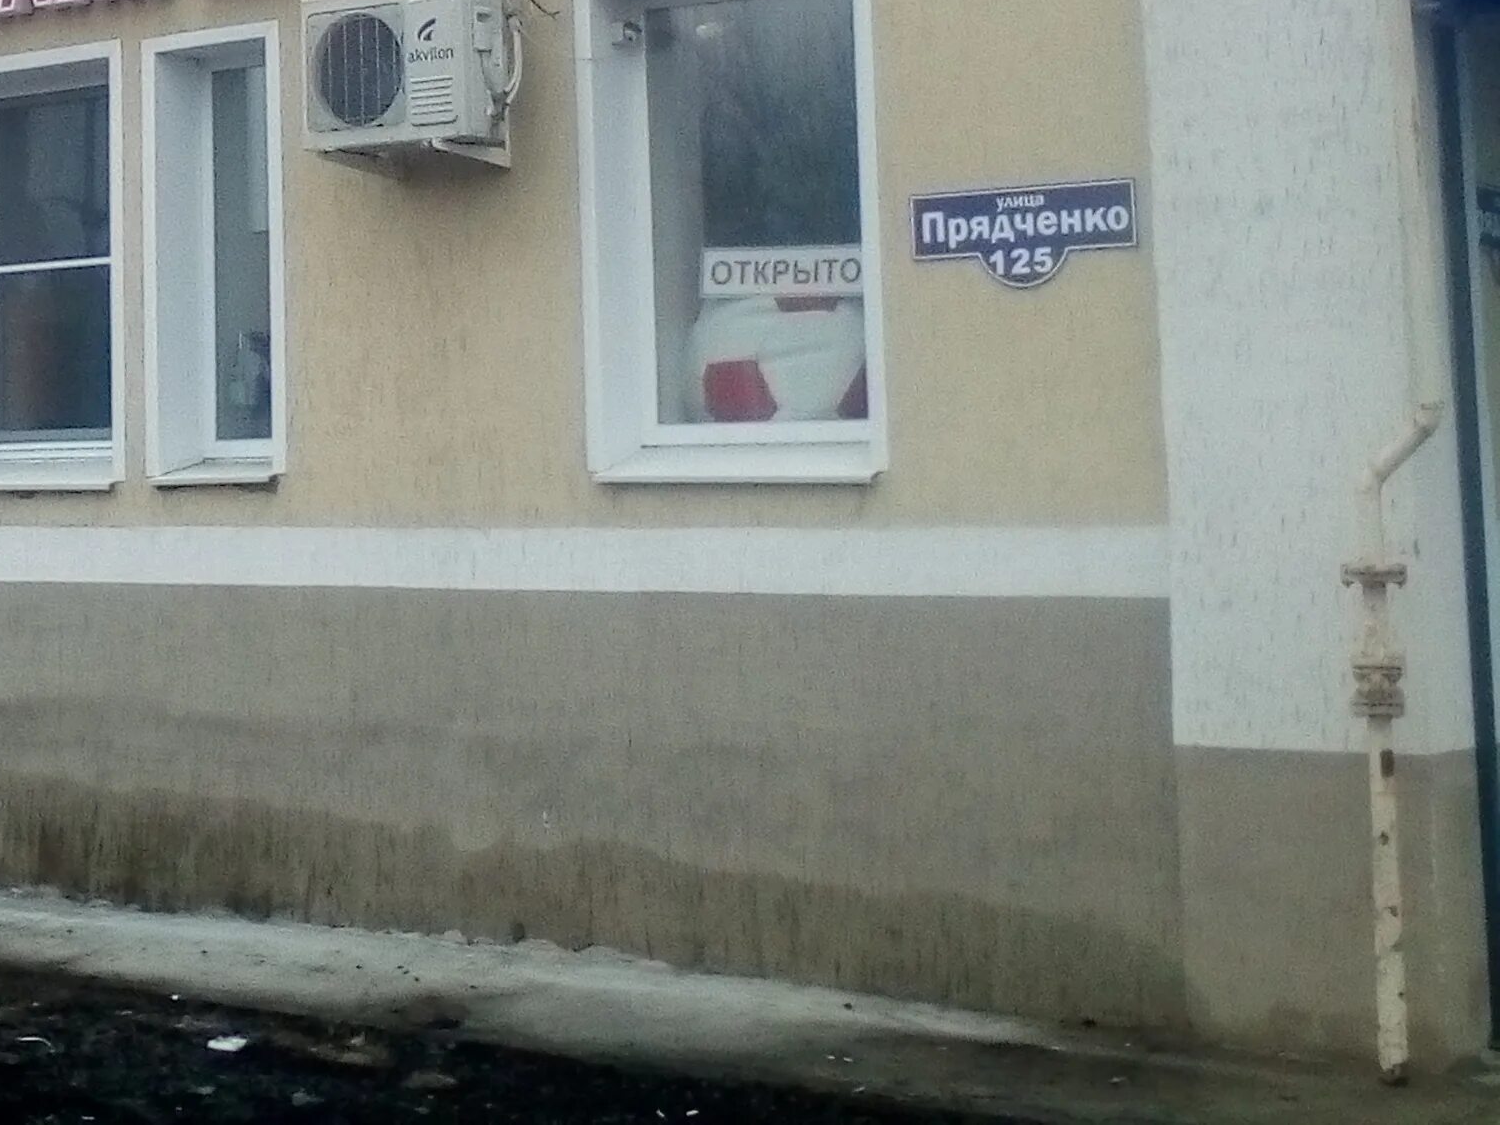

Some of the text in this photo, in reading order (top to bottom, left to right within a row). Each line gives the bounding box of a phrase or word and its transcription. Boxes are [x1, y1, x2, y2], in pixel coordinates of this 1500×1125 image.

[996, 193, 1046, 212] улица
[921, 205, 1130, 249] Прядченко
[711, 258, 862, 285] ОТКРЫТО
[989, 247, 1054, 275] 125
